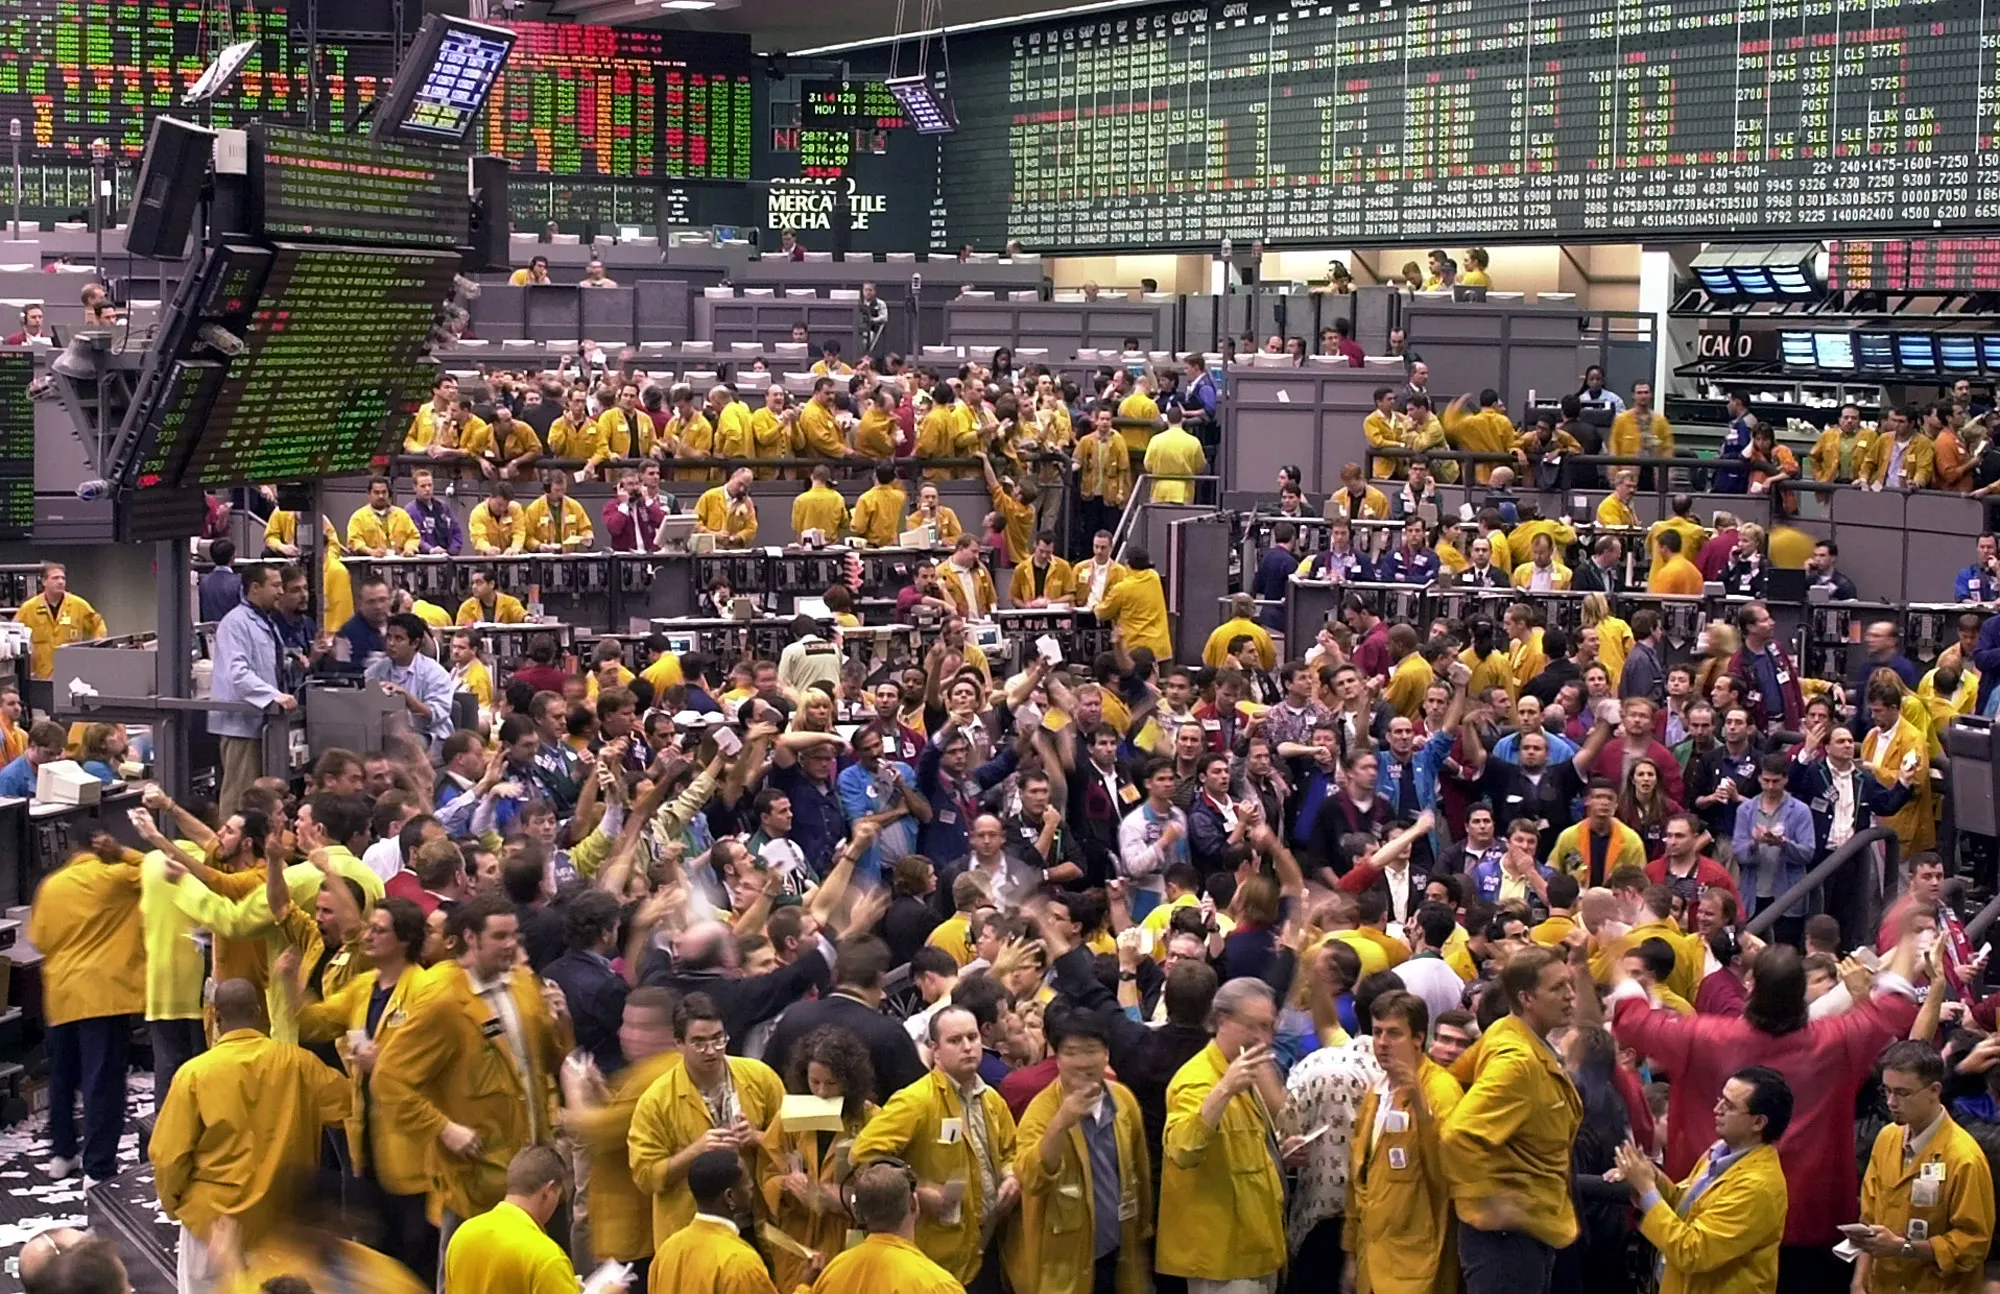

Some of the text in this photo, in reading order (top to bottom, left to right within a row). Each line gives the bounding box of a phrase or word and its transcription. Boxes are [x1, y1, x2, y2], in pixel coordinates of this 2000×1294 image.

[1648, 20, 1671, 33] 4620
[1773, 7, 1798, 19] 9945
[1805, 3, 1831, 16] 9329
[1776, 53, 1797, 66] CLS
[1809, 50, 1830, 63] CLS
[1844, 47, 1865, 60] CLS
[1646, 65, 1670, 78] 4620
[1771, 69, 1797, 82] 9945
[1803, 67, 1830, 80] 9352
[1802, 83, 1830, 96] 9345
[843, 105, 857, 115] 13
[1801, 99, 1828, 112] POST
[1801, 114, 1827, 127] 9351
[1870, 109, 1899, 123] GLBX
[1905, 107, 1935, 120] GLBX
[801, 131, 849, 142] 2837.74
[1774, 132, 1795, 145] SLE
[1807, 130, 1828, 143] SLE
[1841, 128, 1862, 141] SLE
[1766, 179, 1793, 192] 9945
[1799, 178, 1826, 191] 9326
[1833, 176, 1860, 190] 4730
[1867, 174, 1895, 188] 7250
[1902, 173, 1931, 186] 9300
[1939, 172, 1968, 185] 7250
[768, 195, 887, 212] MERCATILE
[1765, 195, 1792, 207] 9968
[768, 212, 869, 229] EXCHAE
[1765, 210, 1792, 223] 9792
[1798, 210, 1826, 222] 9225
[1902, 206, 1930, 220] 4500
[1937, 205, 1967, 218] 6200
